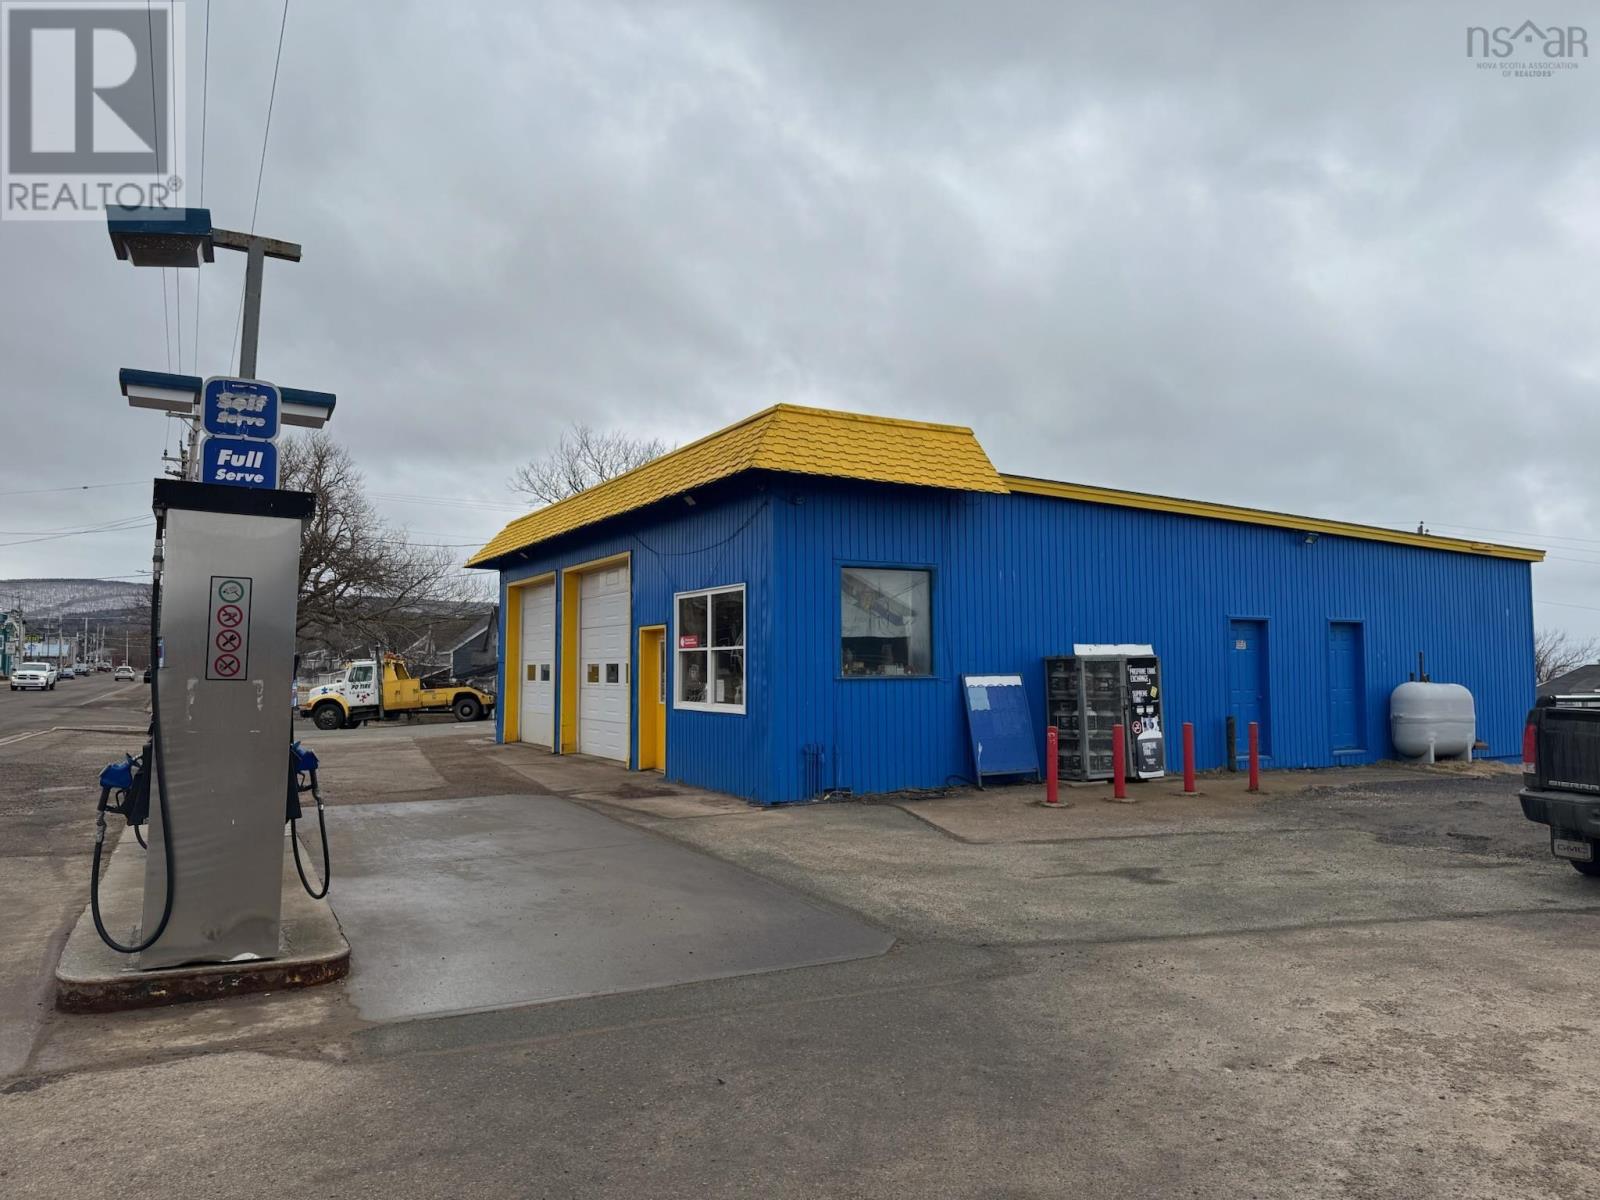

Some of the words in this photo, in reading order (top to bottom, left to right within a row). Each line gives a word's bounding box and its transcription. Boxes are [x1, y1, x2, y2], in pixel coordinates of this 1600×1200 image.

[216, 392, 267, 412] Self
[217, 449, 264, 468] Full
[215, 468, 264, 483] Serve
[1548, 780, 1600, 790] SIERRA
[1557, 843, 1589, 855] GMC
